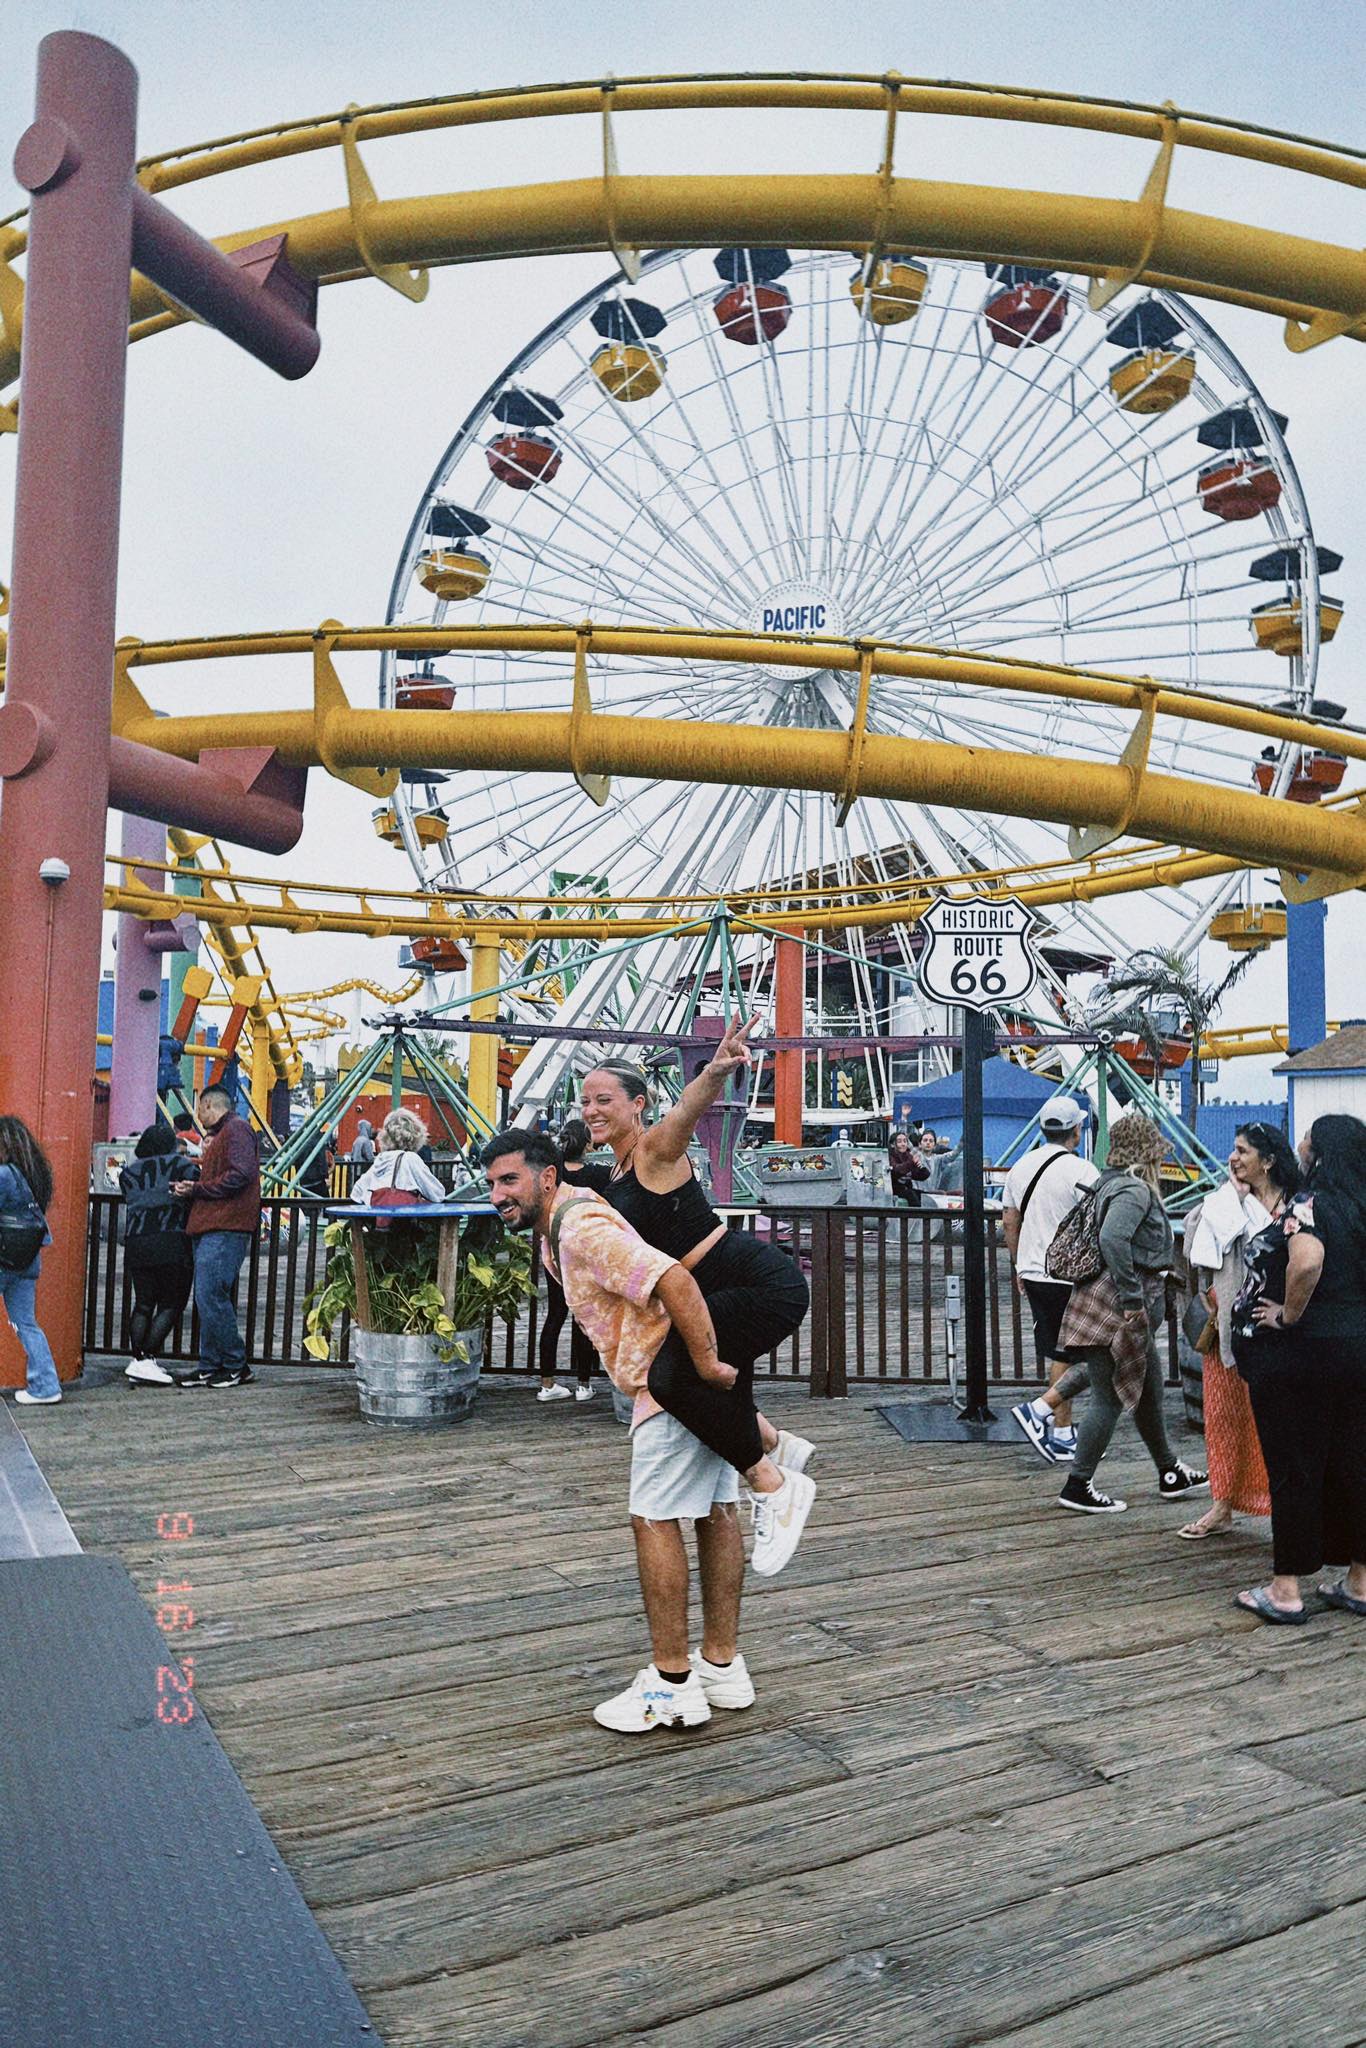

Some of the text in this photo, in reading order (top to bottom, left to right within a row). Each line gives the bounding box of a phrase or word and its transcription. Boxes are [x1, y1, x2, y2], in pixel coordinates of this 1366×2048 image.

[763, 604, 826, 632] PACIFIC
[942, 910, 1014, 928] HISTORIC
[954, 937, 1003, 956] ROUTE
[950, 958, 1007, 995] 66
